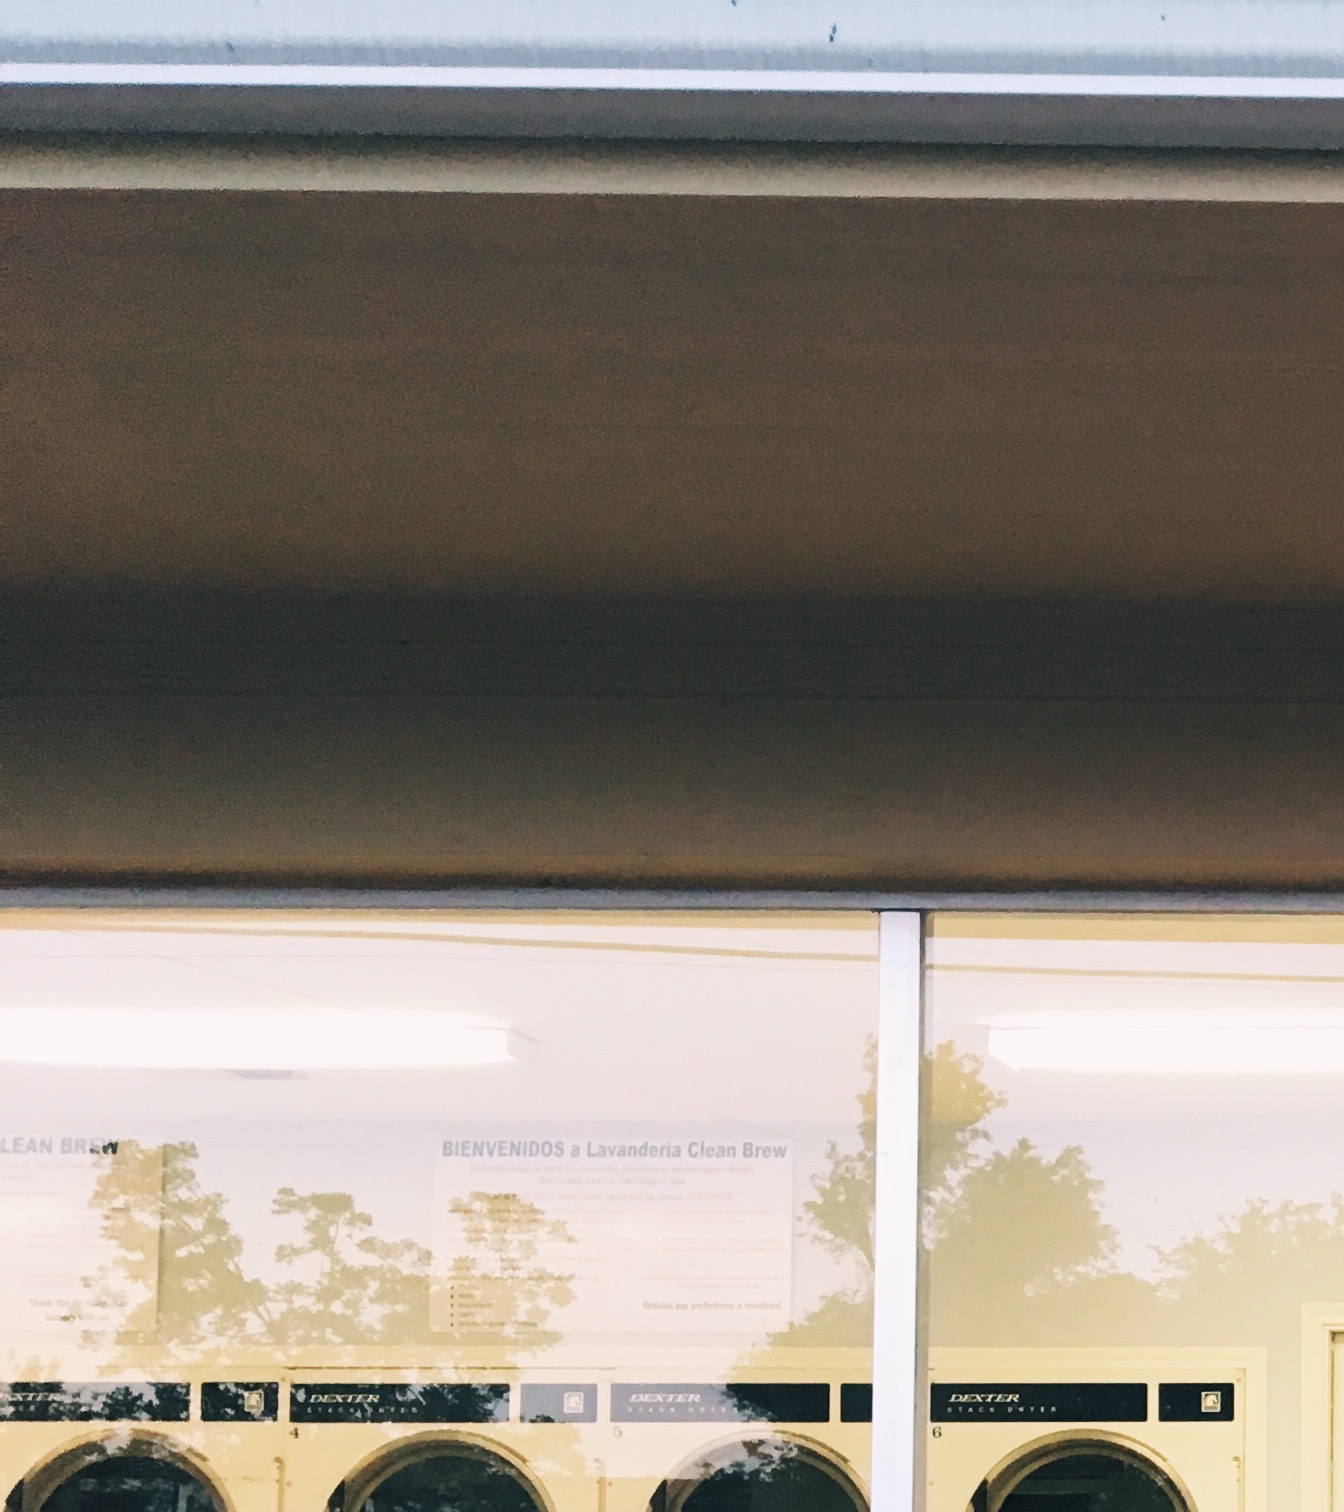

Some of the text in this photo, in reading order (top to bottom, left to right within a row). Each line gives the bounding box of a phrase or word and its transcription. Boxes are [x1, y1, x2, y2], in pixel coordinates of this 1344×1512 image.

[442, 1140, 788, 1159] BIENVENIDOS a Lavanderia Clean Brew
[309, 1393, 381, 1403] DEXTER
[629, 1393, 701, 1403] DEXTER
[948, 1393, 1021, 1403] DEXTER
[289, 1427, 300, 1439] 4
[612, 1426, 623, 1438] 5
[931, 1426, 943, 1438] 6
